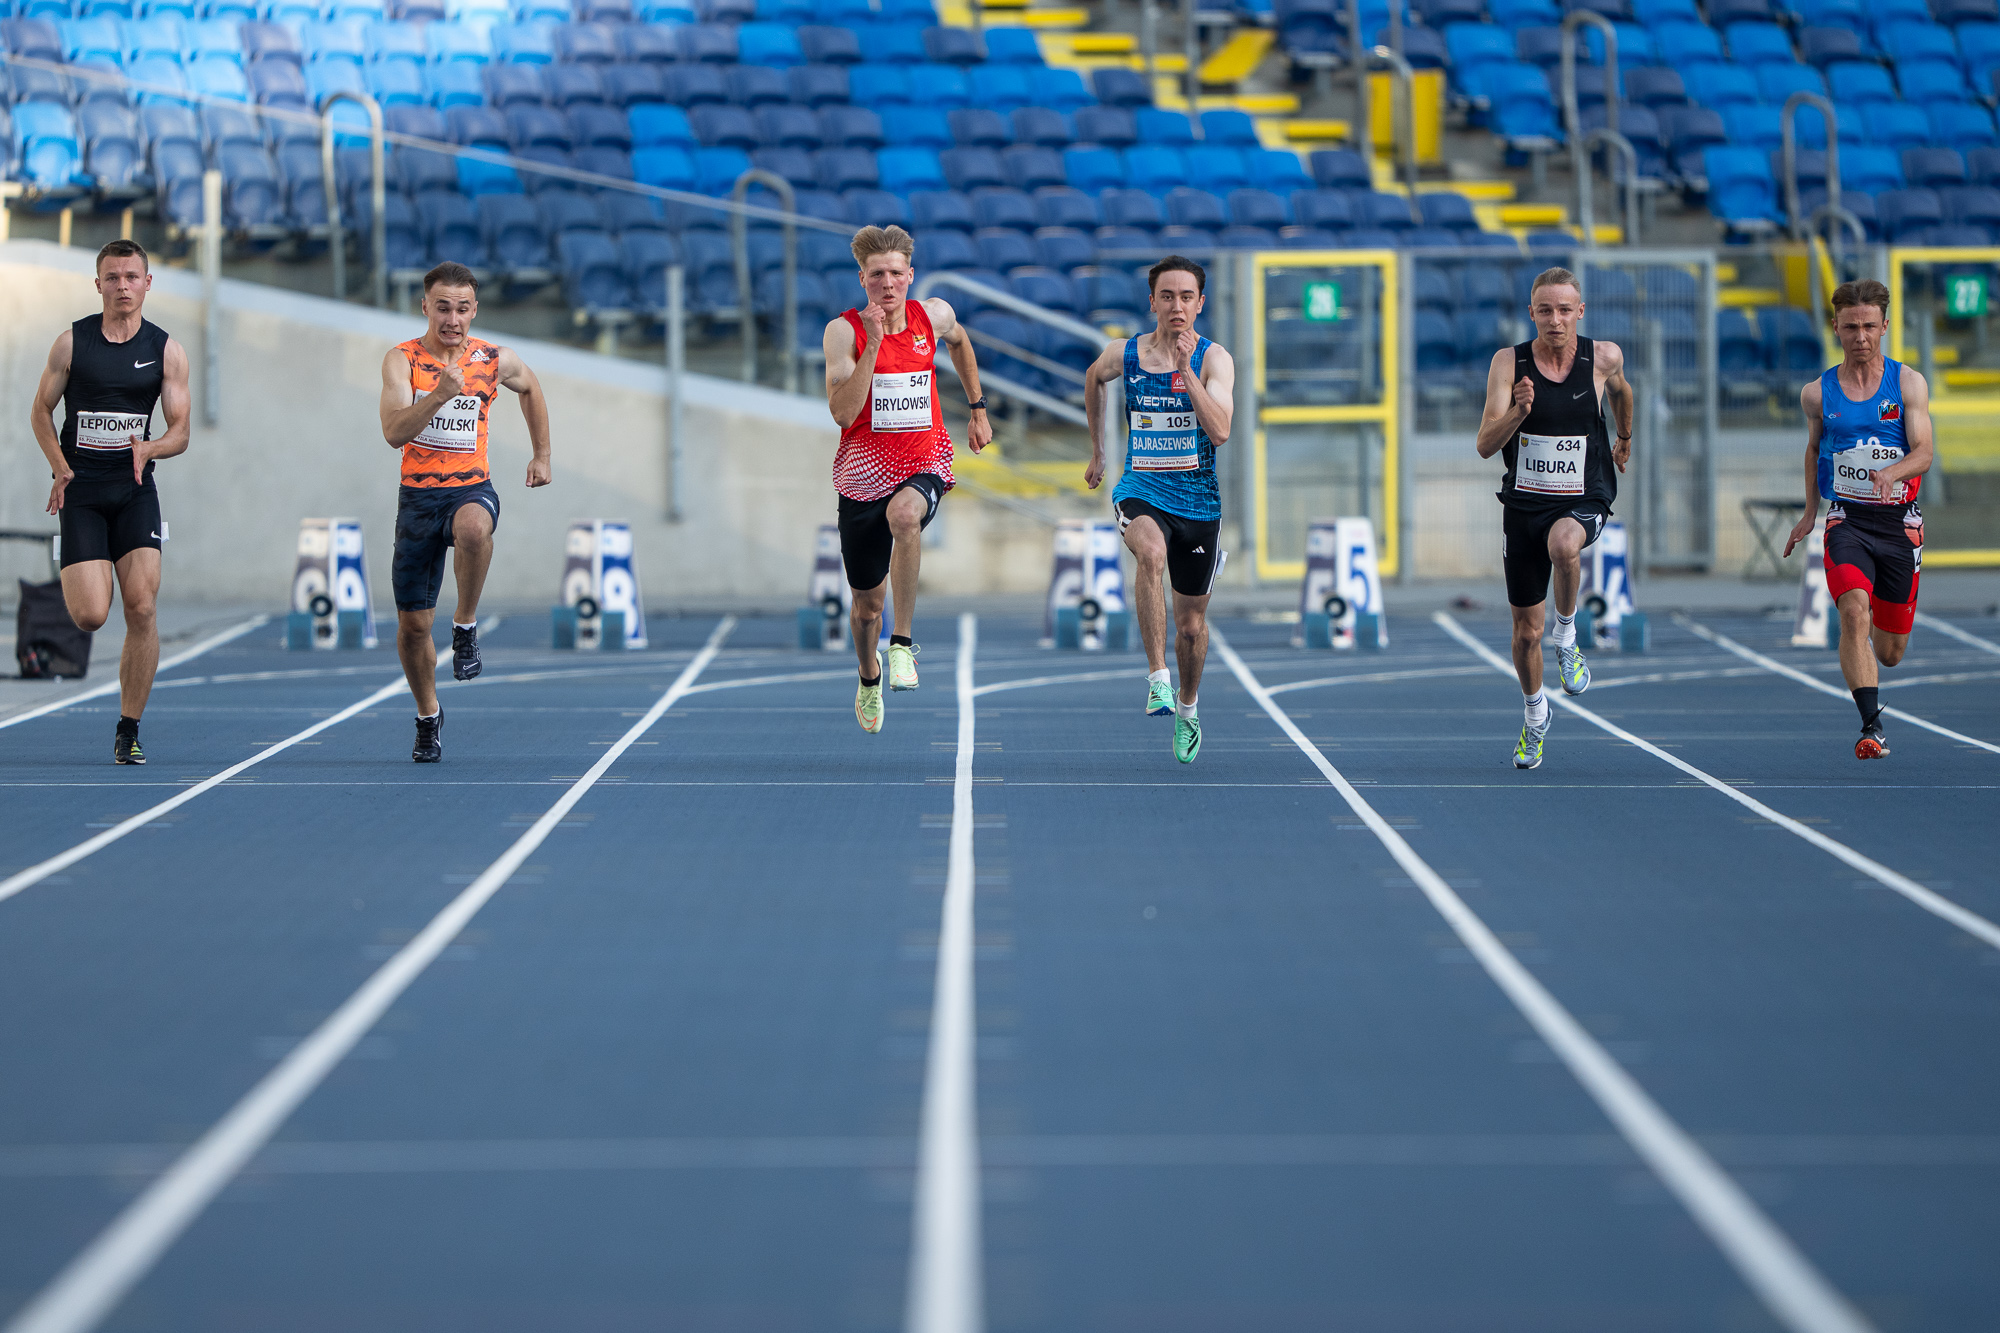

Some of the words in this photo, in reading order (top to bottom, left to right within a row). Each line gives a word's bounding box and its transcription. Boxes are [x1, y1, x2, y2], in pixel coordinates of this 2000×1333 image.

[909, 374, 929, 387] 547
[453, 399, 476, 410] 362
[875, 396, 931, 412] BRYLOWSKI
[1136, 395, 1183, 407] VECTRA
[80, 418, 143, 431] LEPIONKA
[428, 416, 475, 431] ATULSKI
[1166, 416, 1191, 428] 105
[1132, 435, 1196, 451] BAJRASZEWSKI
[1556, 439, 1580, 452] 634
[1871, 448, 1898, 460] 838
[1525, 457, 1577, 474] LIBURA
[1350, 546, 1370, 611] 5
